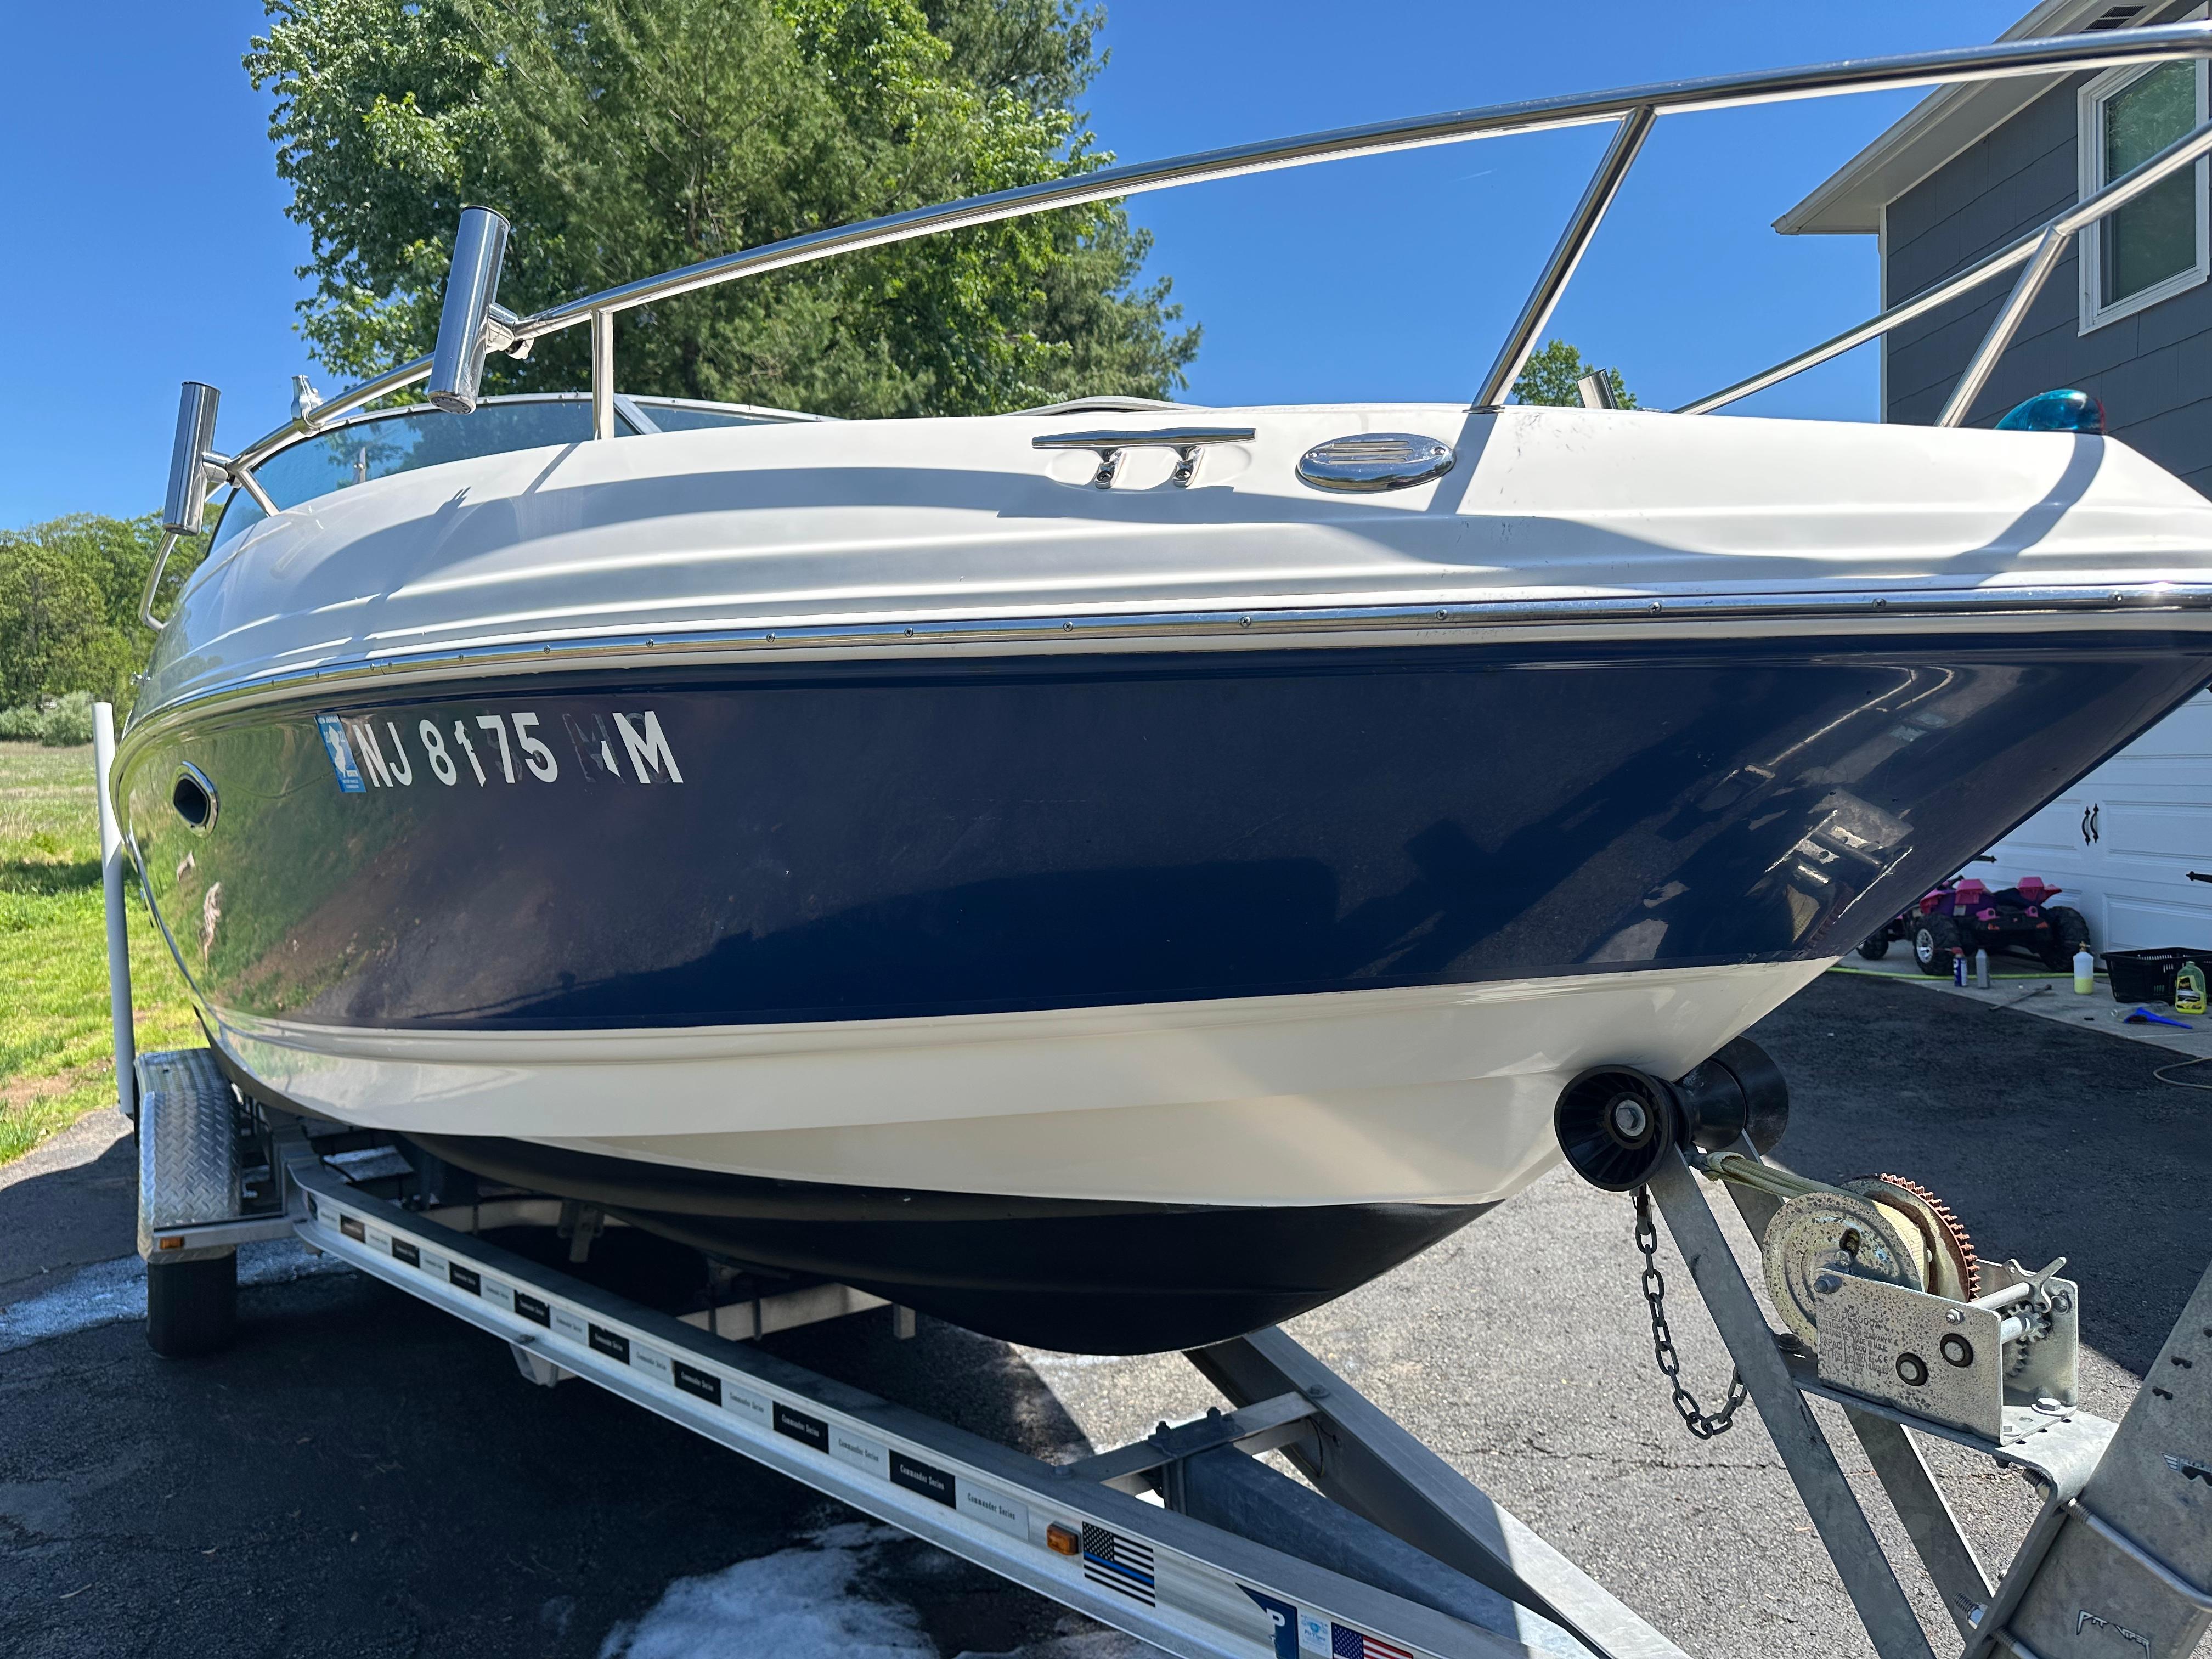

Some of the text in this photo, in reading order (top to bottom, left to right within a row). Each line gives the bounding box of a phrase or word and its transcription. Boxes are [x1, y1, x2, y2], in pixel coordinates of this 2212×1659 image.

[352, 721, 413, 787] NJ
[419, 712, 558, 787] 8175
[967, 1492, 1015, 1520] Commander Series
